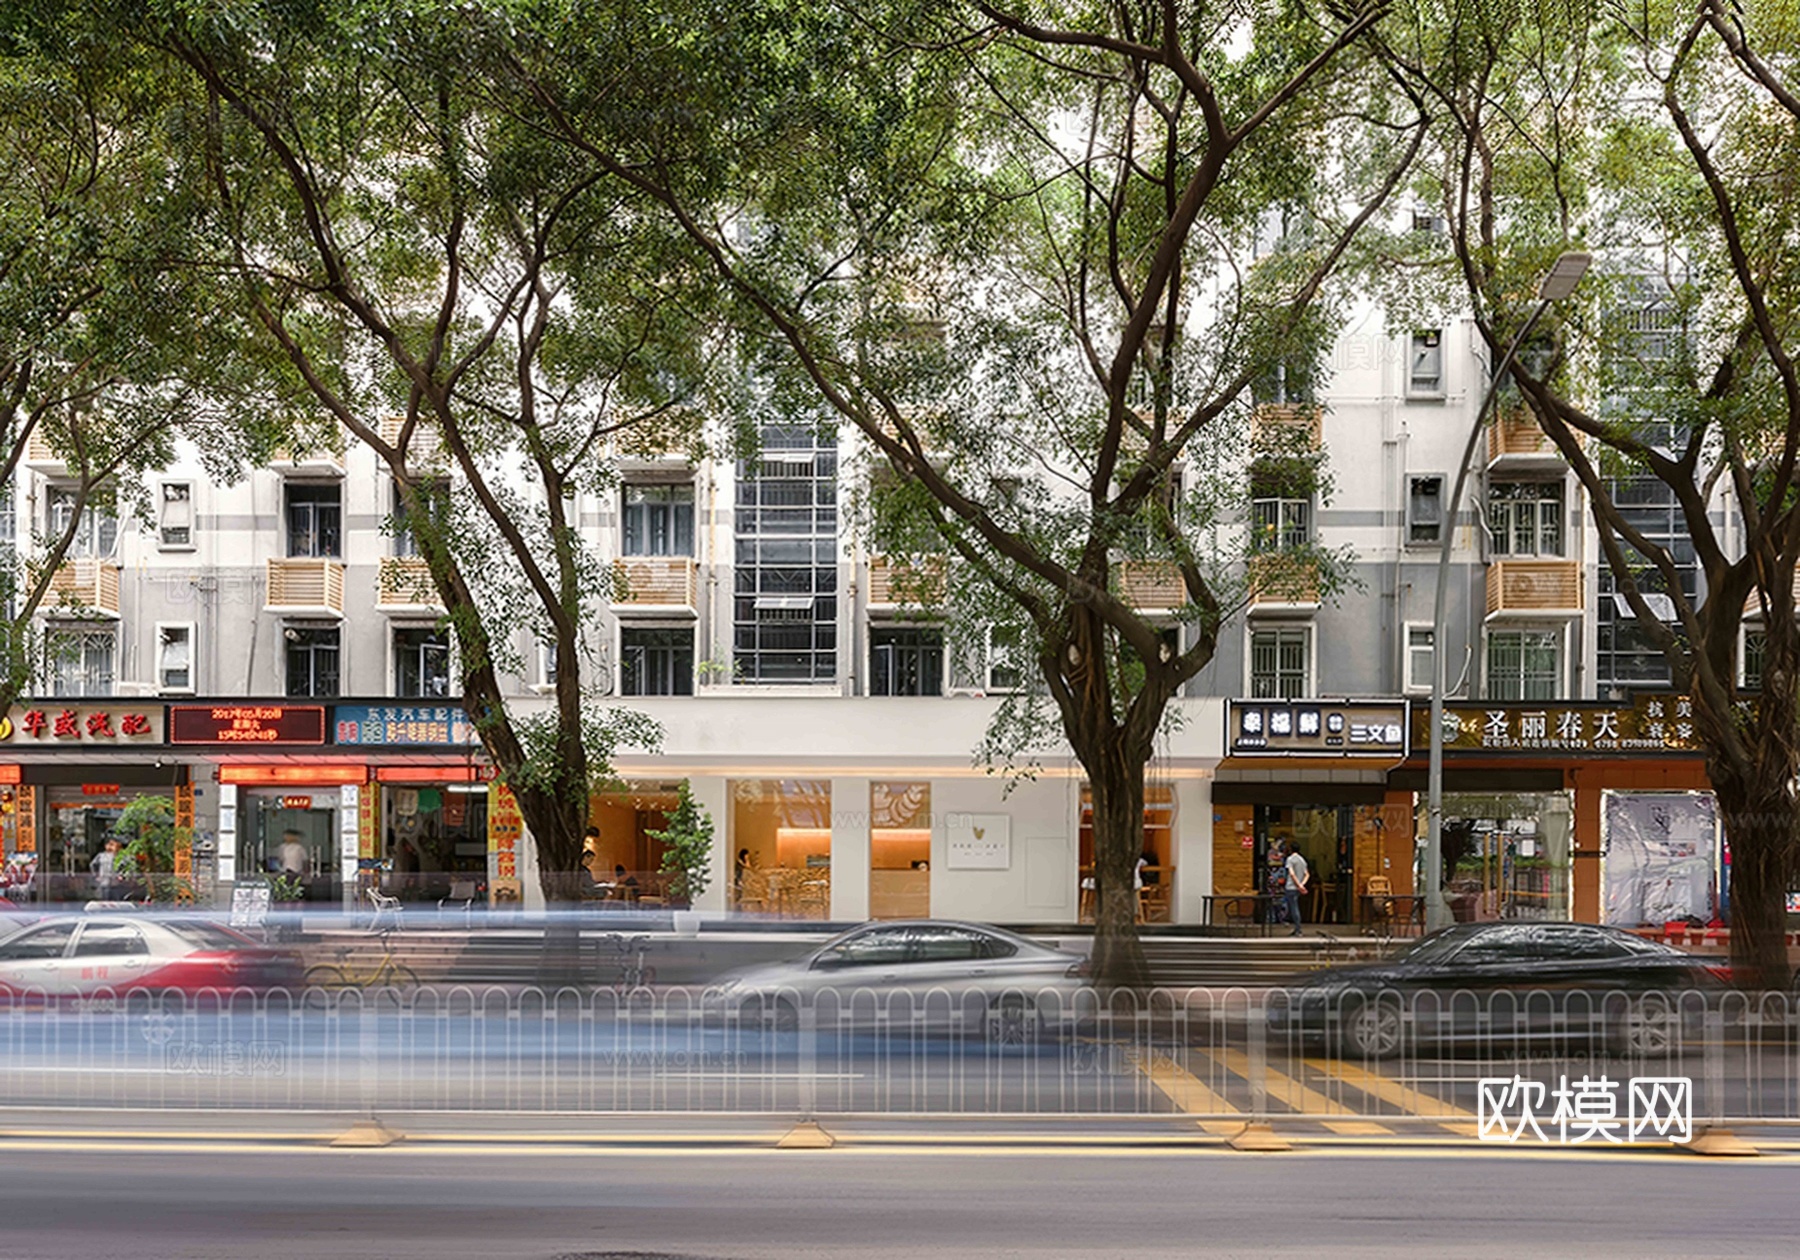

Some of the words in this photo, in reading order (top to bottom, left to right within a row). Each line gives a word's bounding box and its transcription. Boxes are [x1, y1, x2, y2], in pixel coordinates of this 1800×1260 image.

[1350, 724, 1402, 742] 三文鱼
[1483, 710, 1619, 738] 圣丽春天
